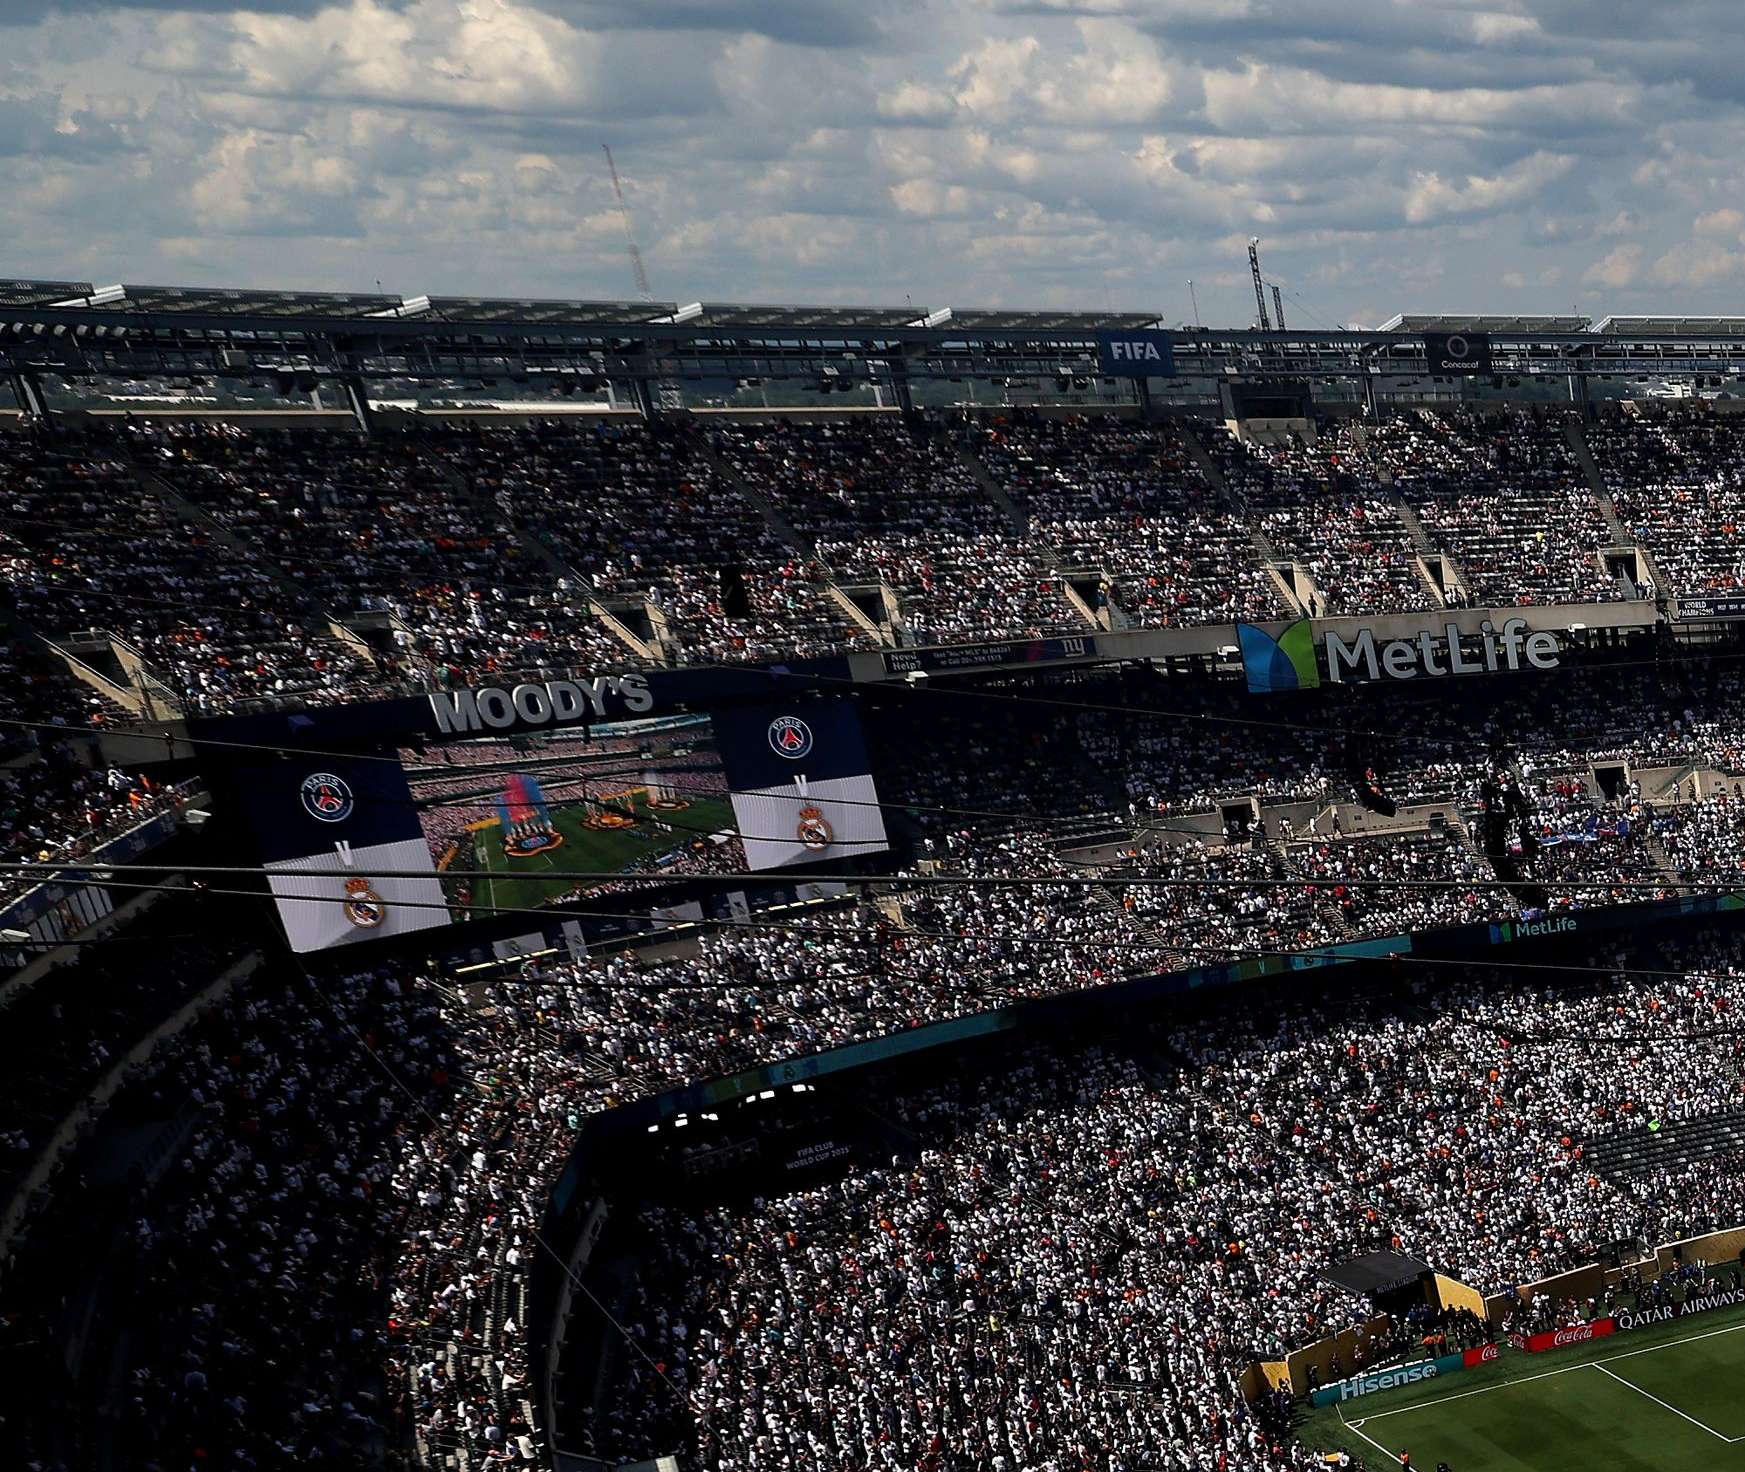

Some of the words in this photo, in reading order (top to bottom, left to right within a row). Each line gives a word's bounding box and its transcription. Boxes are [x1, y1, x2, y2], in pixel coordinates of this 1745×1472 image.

[1110, 342, 1162, 360] FIFA
[1441, 359, 1480, 370] Concacaf
[1322, 616, 1561, 683] MetLife
[428, 672, 654, 735] MOODY'S
[772, 717, 802, 730] PARIS
[303, 774, 341, 791] PARIS
[1515, 916, 1577, 938] MetLife
[814, 1141, 834, 1153] CLUB
[785, 1156, 812, 1170] WORLD
[1619, 1306, 1674, 1331] QATAR
[1678, 1288, 1745, 1316] AIRWAYS
[1340, 1363, 1438, 1401] Hisense
